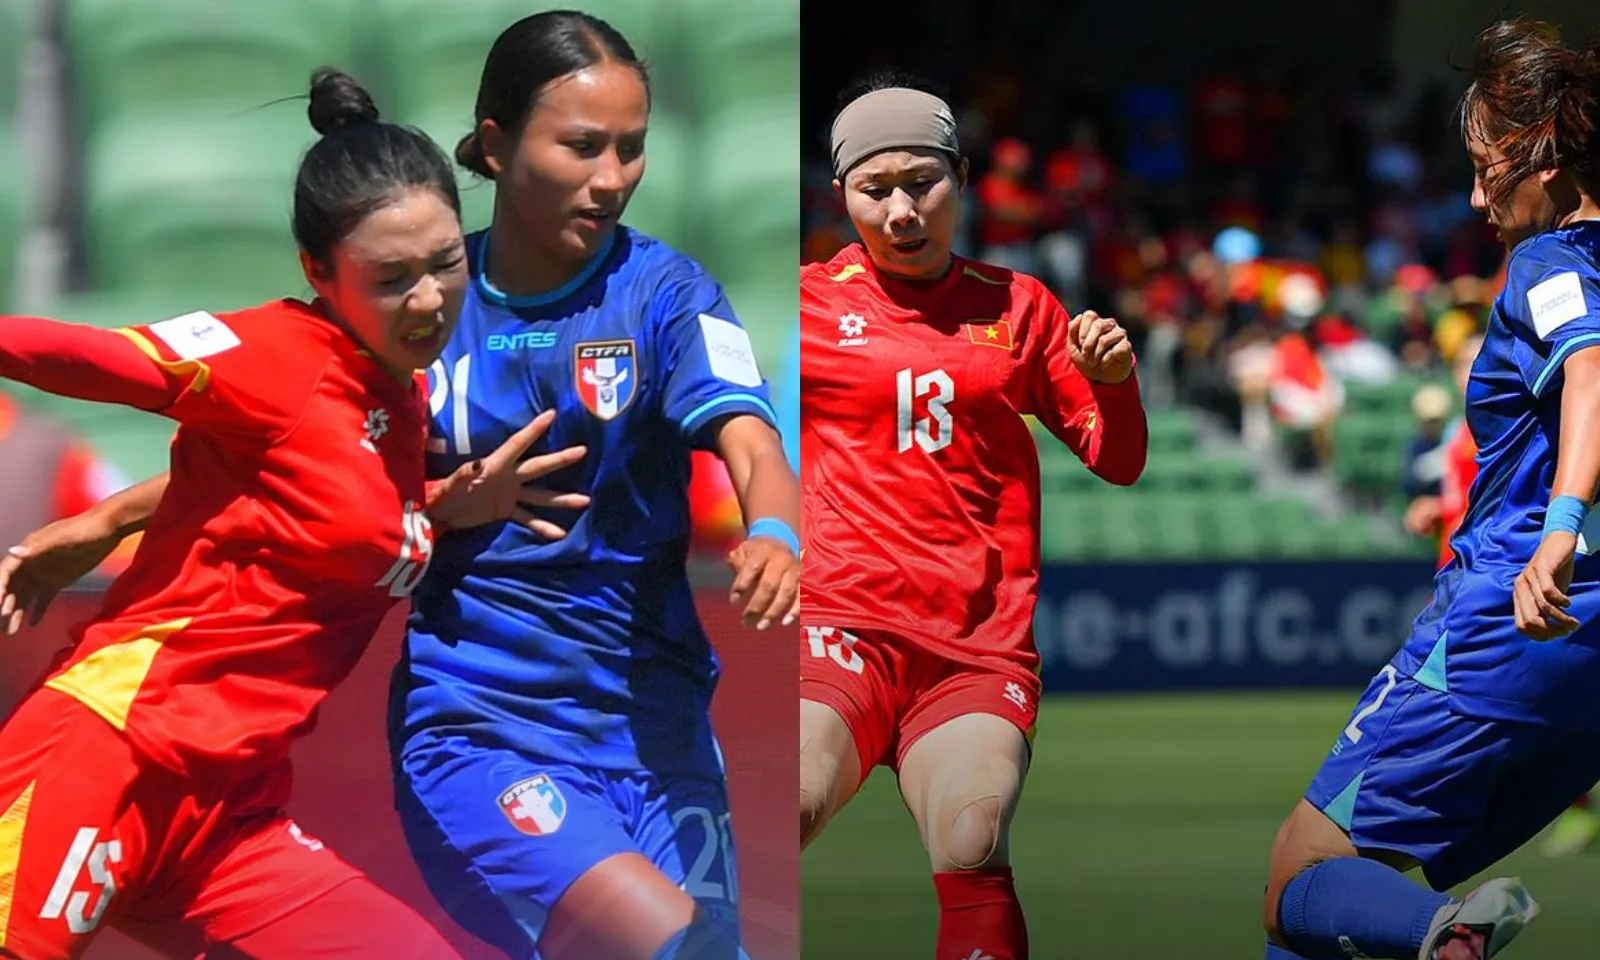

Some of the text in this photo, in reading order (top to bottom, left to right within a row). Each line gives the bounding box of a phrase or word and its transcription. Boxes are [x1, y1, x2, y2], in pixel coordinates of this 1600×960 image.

[487, 332, 557, 350] ENTES
[581, 346, 629, 357] CTFA
[896, 367, 955, 454] 13
[374, 500, 434, 597] 15
[38, 827, 123, 934] 15
